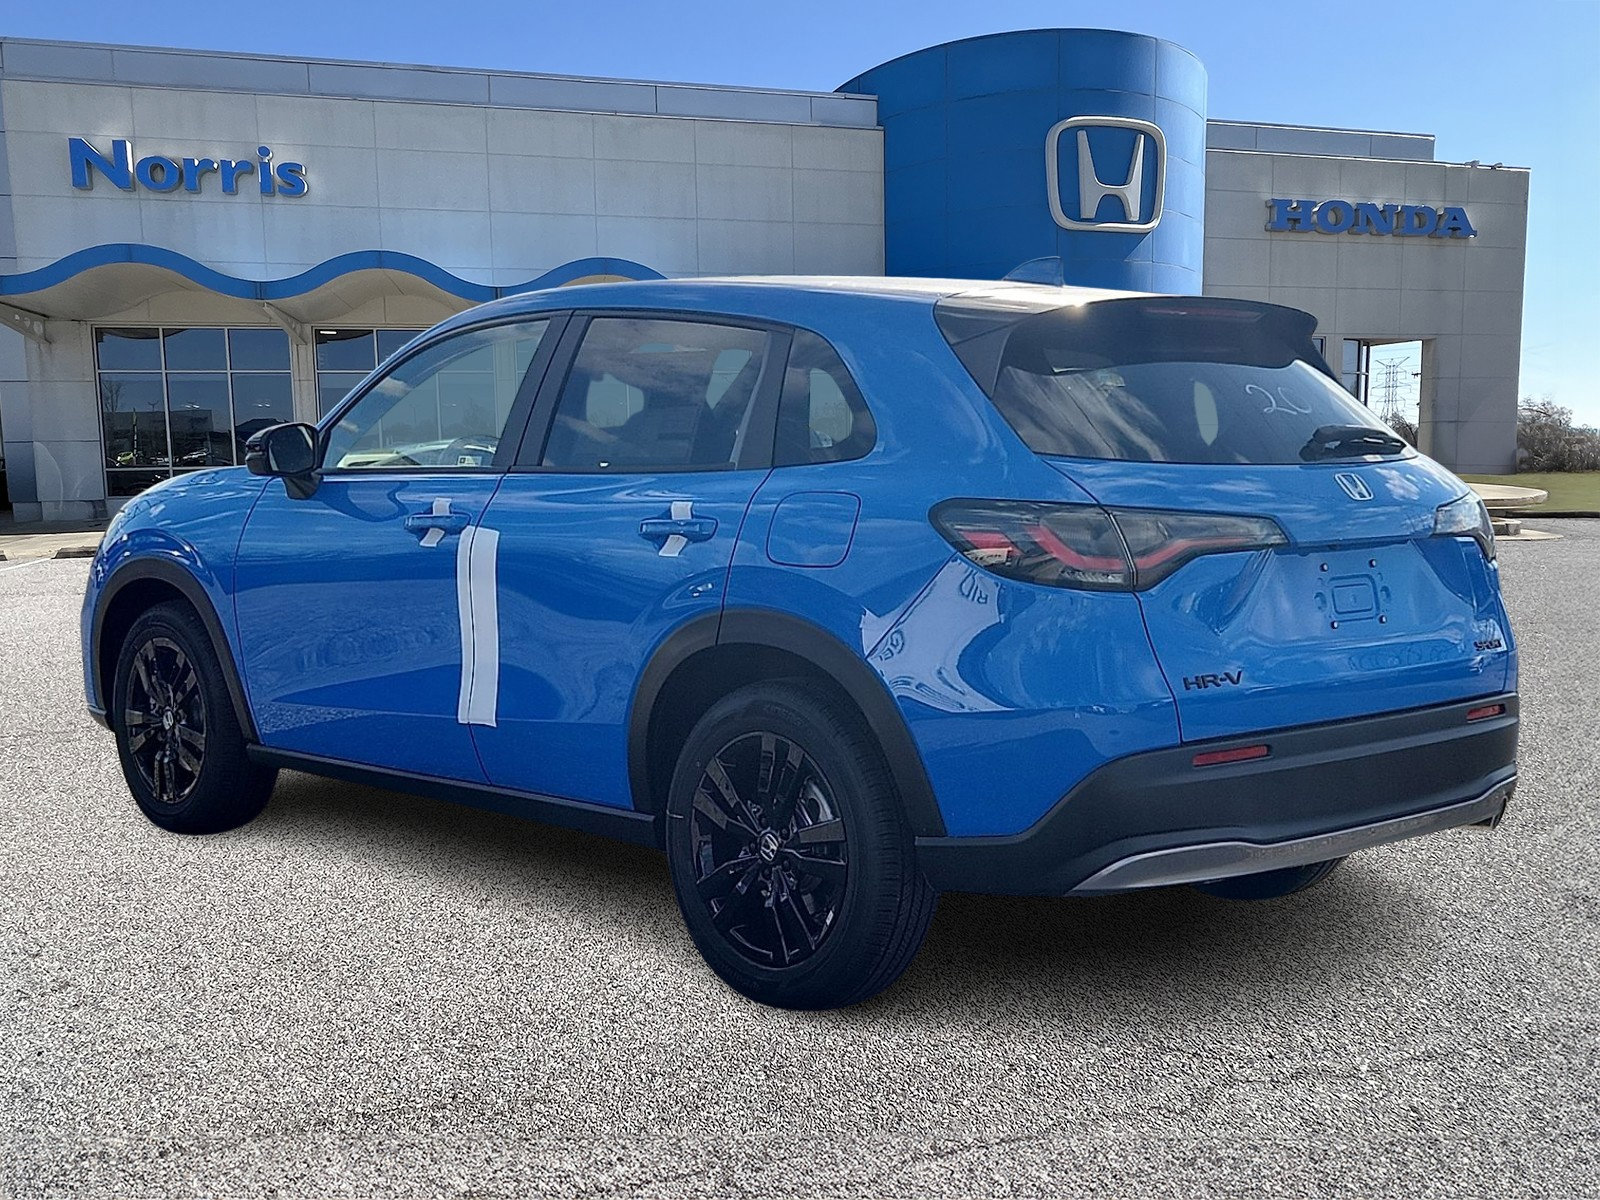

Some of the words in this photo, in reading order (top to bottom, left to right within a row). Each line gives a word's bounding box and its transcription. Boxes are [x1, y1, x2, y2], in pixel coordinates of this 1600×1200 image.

[68, 137, 308, 197] Norris
[1265, 198, 1478, 239] HONDA
[1182, 670, 1243, 691] HR-V
